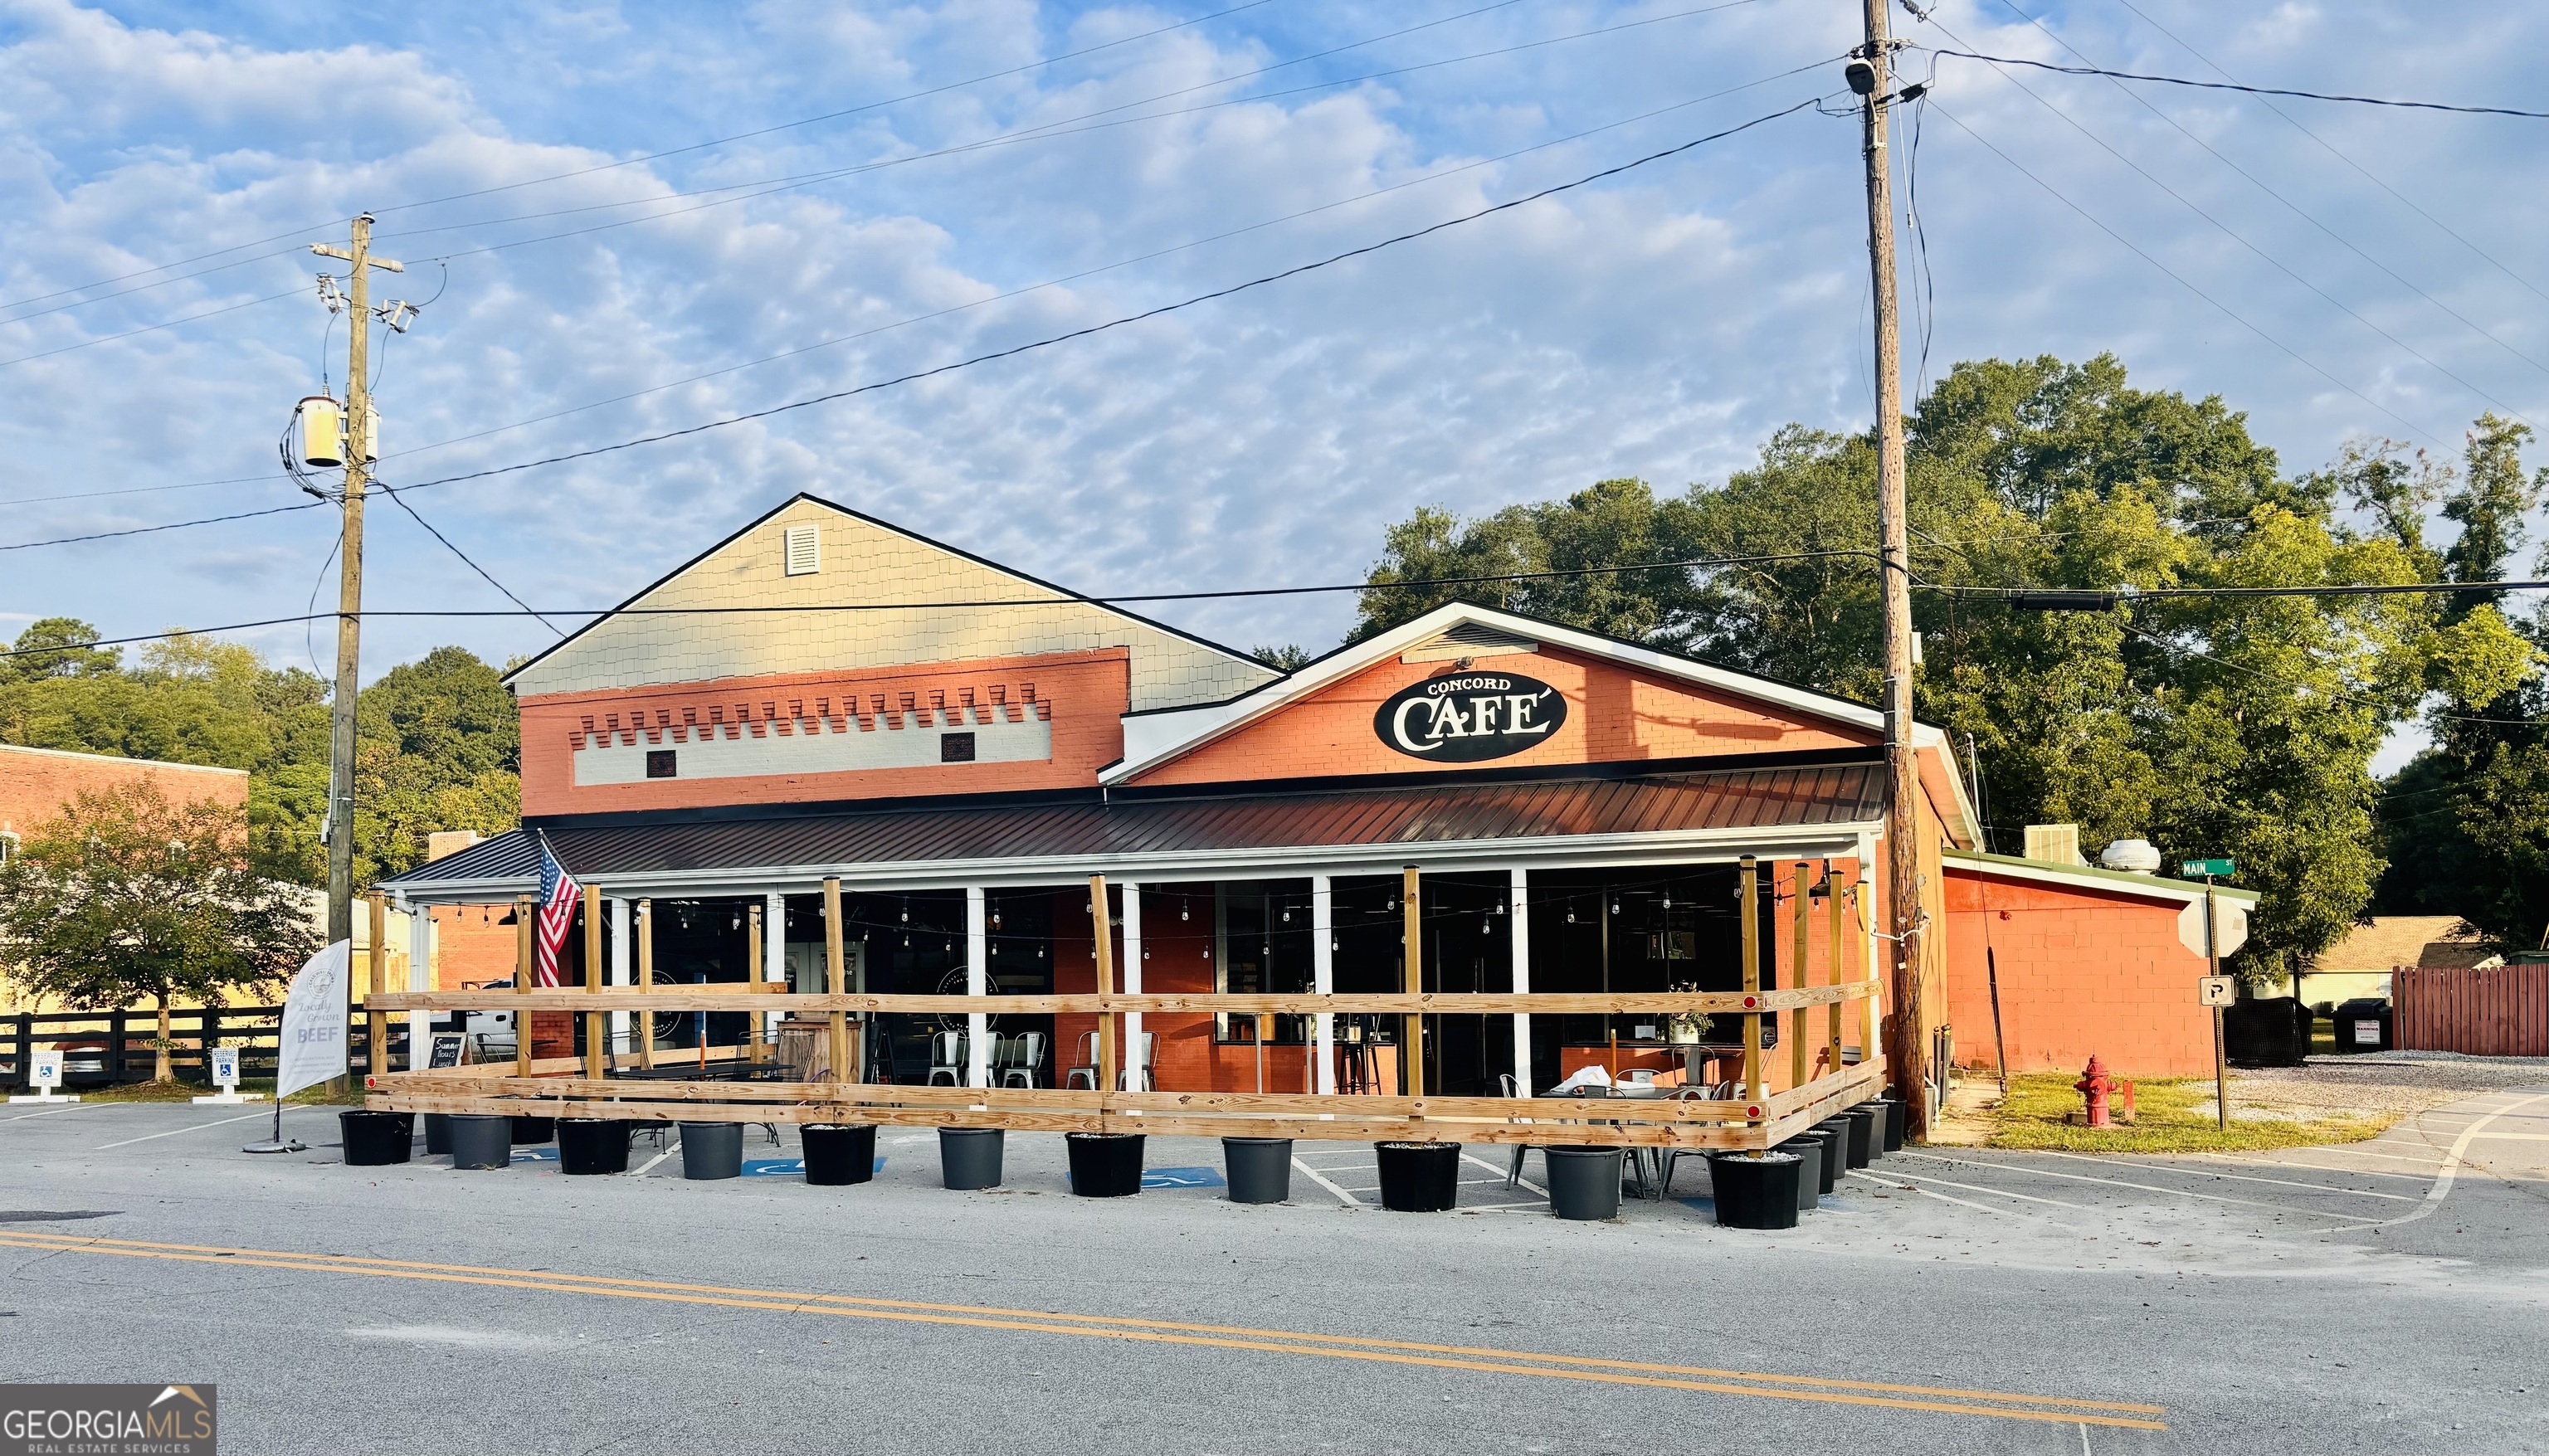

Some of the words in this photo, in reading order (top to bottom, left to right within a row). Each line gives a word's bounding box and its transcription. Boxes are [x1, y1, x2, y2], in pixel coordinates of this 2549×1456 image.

[1427, 678, 1511, 695] CONCORD
[2183, 862, 2206, 874] MAIN
[299, 999, 331, 1012] Locally
[307, 1013, 340, 1023] Grown
[297, 1027, 339, 1044] BEEF
